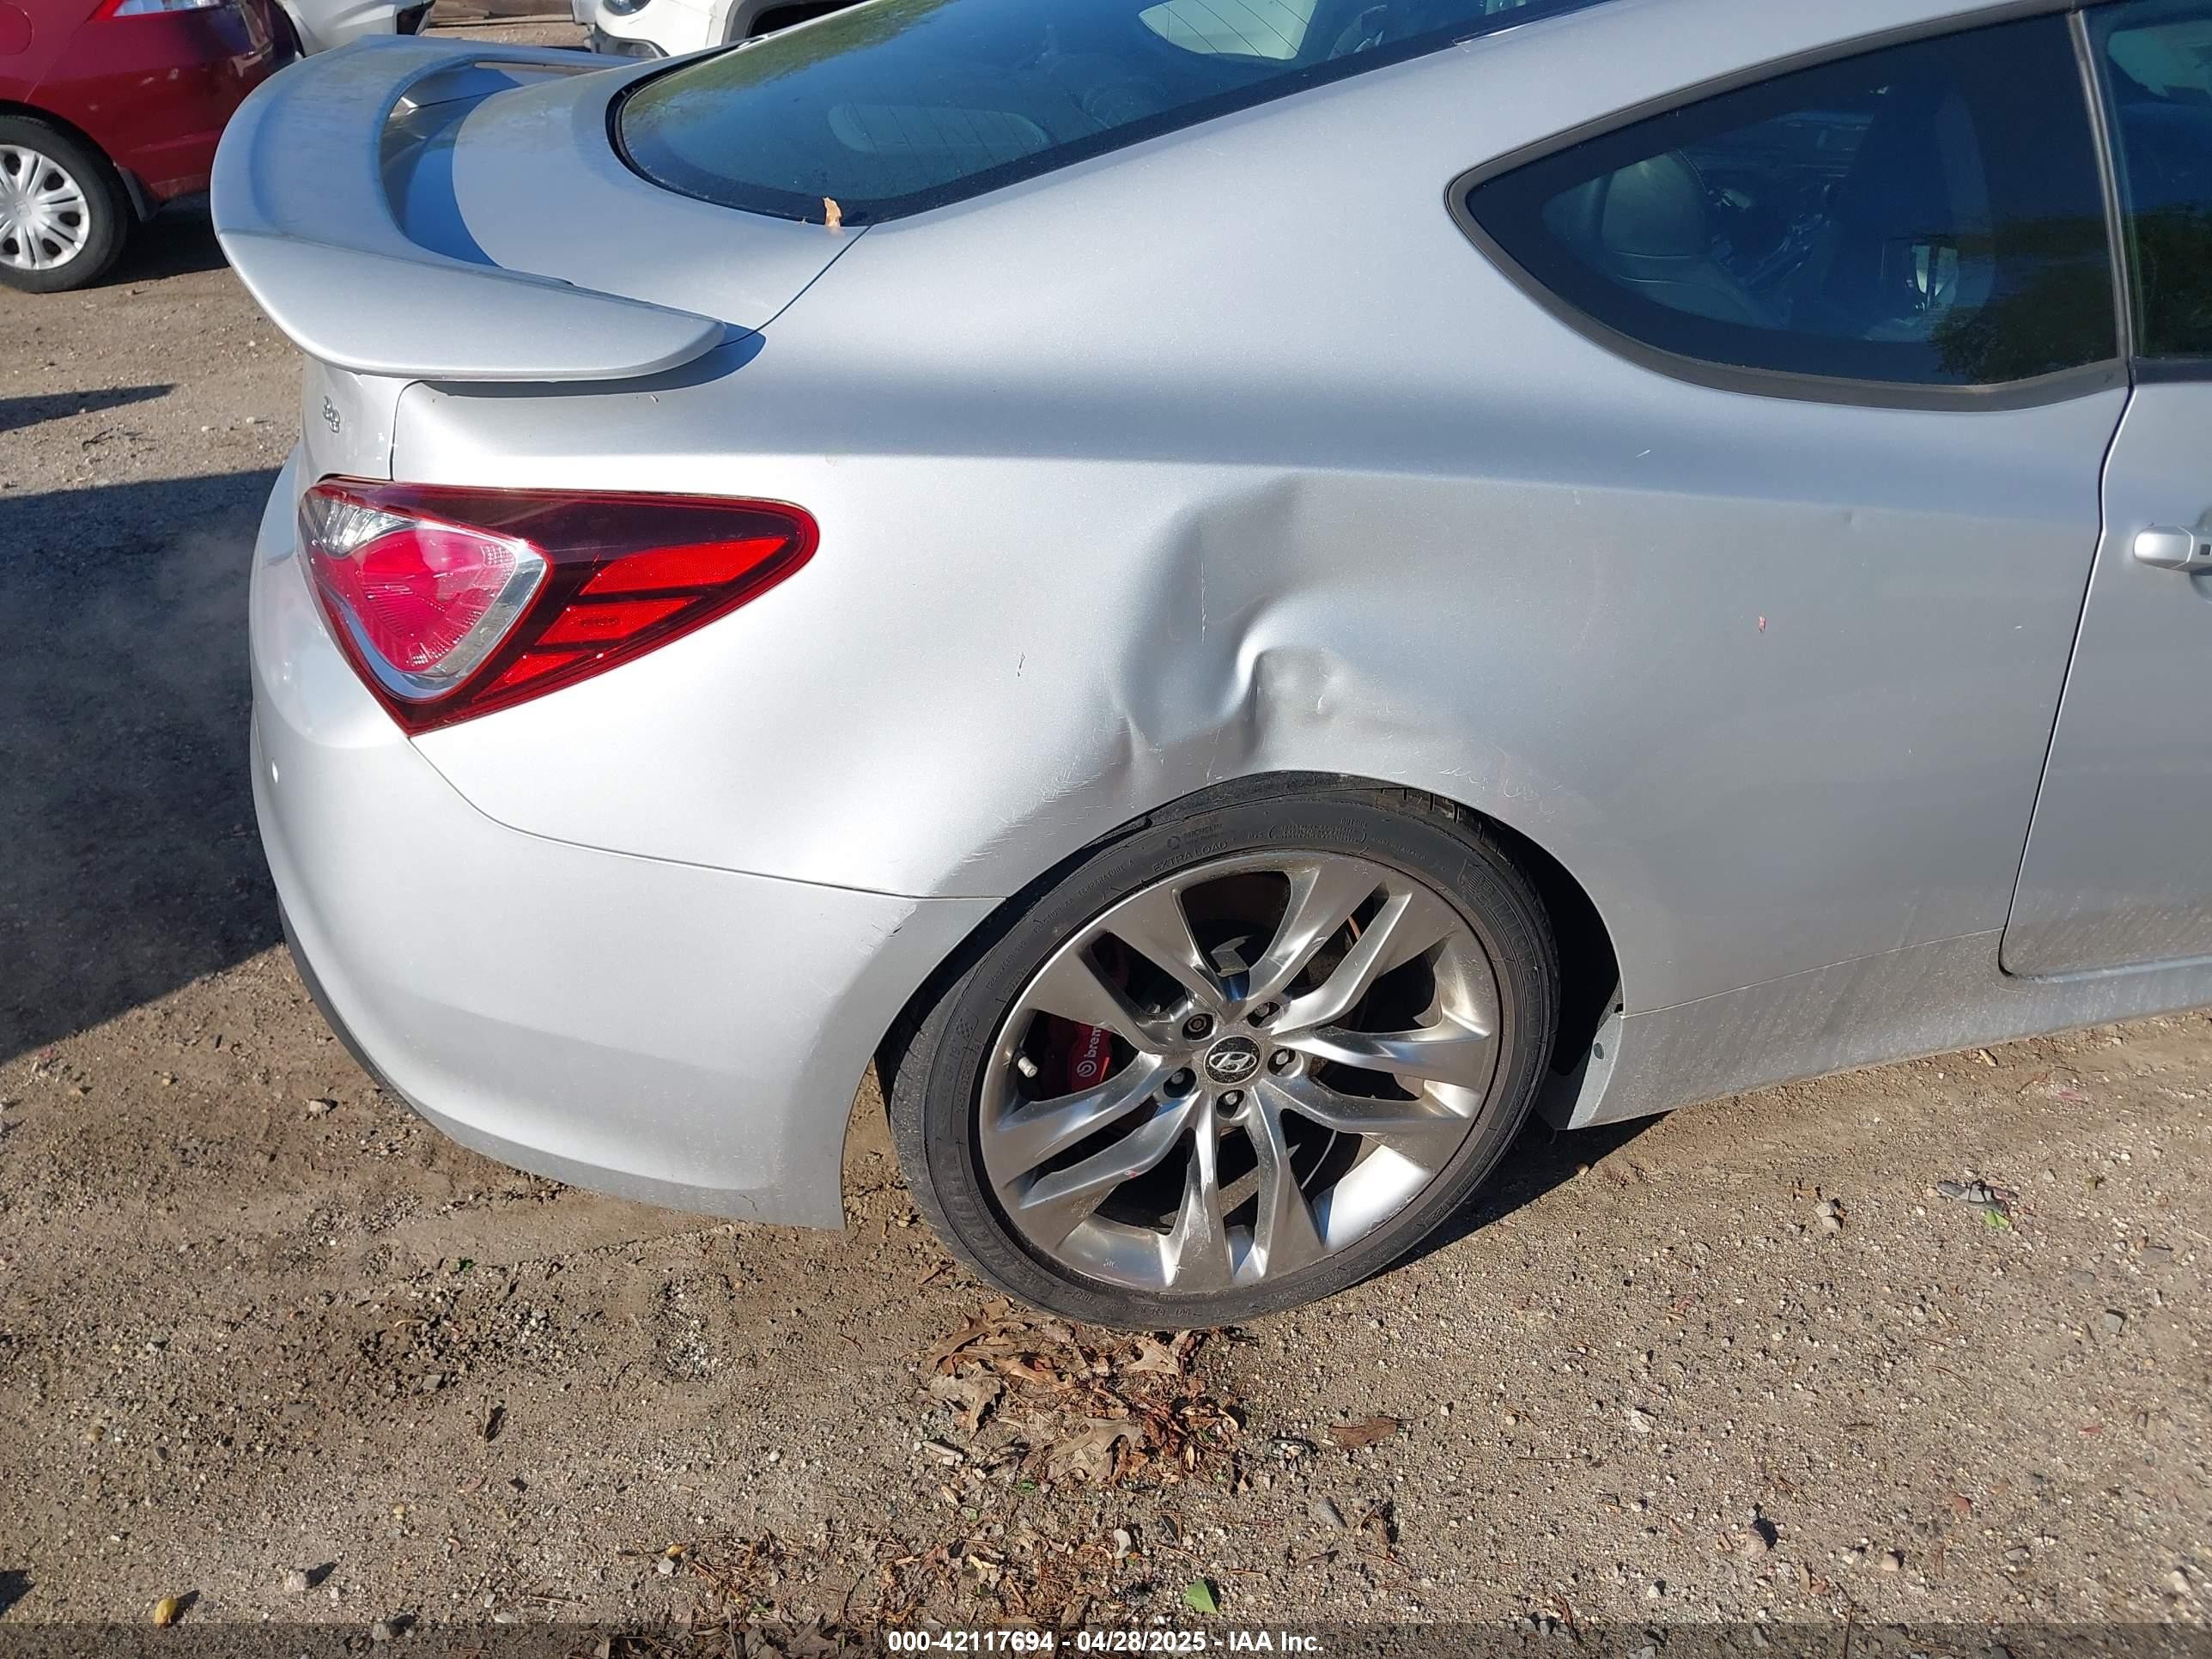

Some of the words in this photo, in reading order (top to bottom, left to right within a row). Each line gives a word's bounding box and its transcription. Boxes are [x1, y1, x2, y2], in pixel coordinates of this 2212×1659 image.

[1152, 851, 1194, 873] EXTRA
[1194, 841, 1228, 856] LOAD
[1077, 864, 1126, 896] TEMPERATURE
